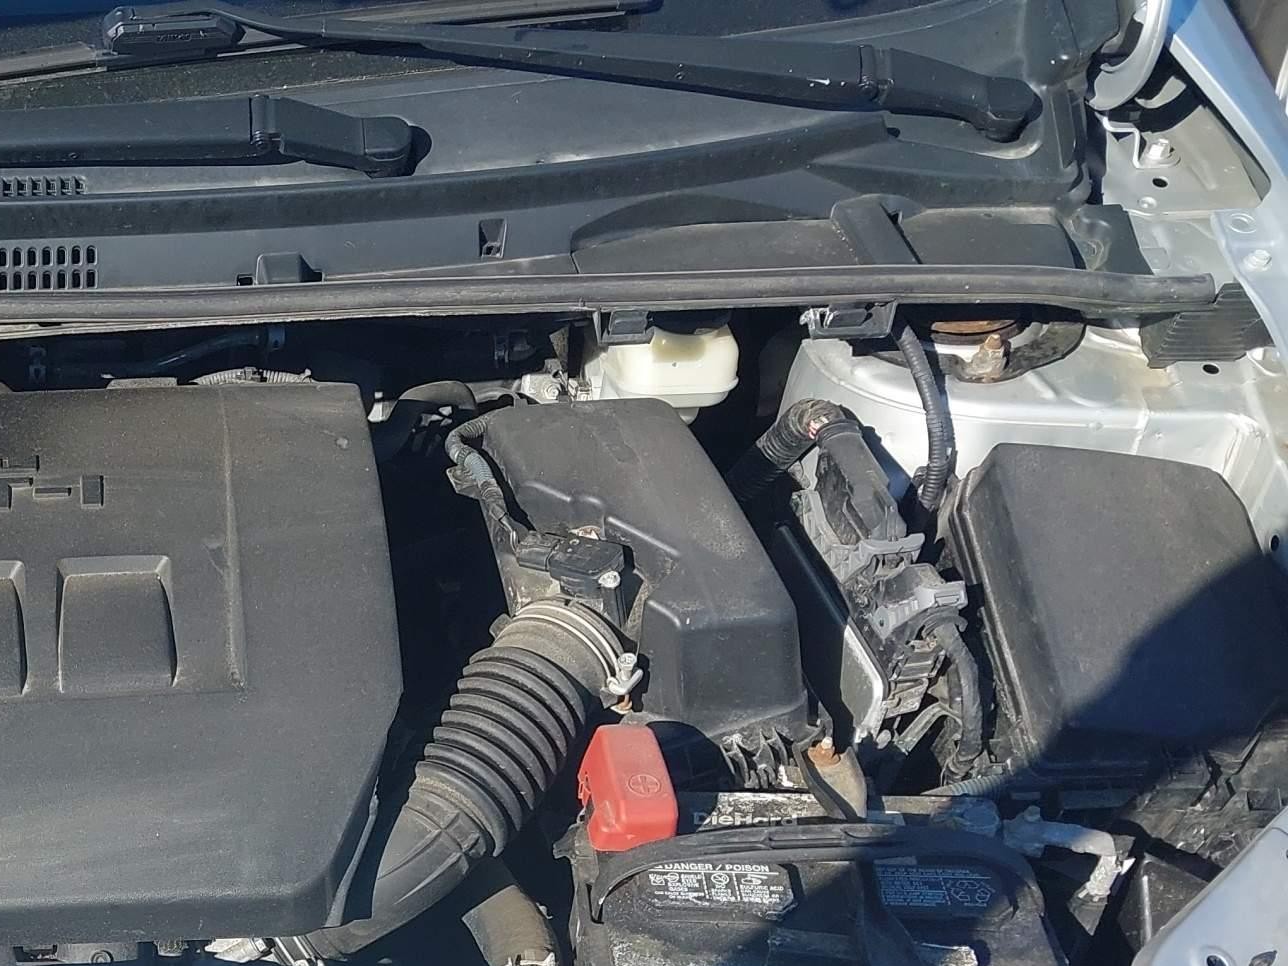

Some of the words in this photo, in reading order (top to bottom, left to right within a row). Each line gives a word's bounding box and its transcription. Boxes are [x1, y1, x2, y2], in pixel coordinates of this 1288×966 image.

[693, 811, 798, 826] DieHard
[664, 862, 713, 871] DANGER
[725, 863, 770, 872] POISON
